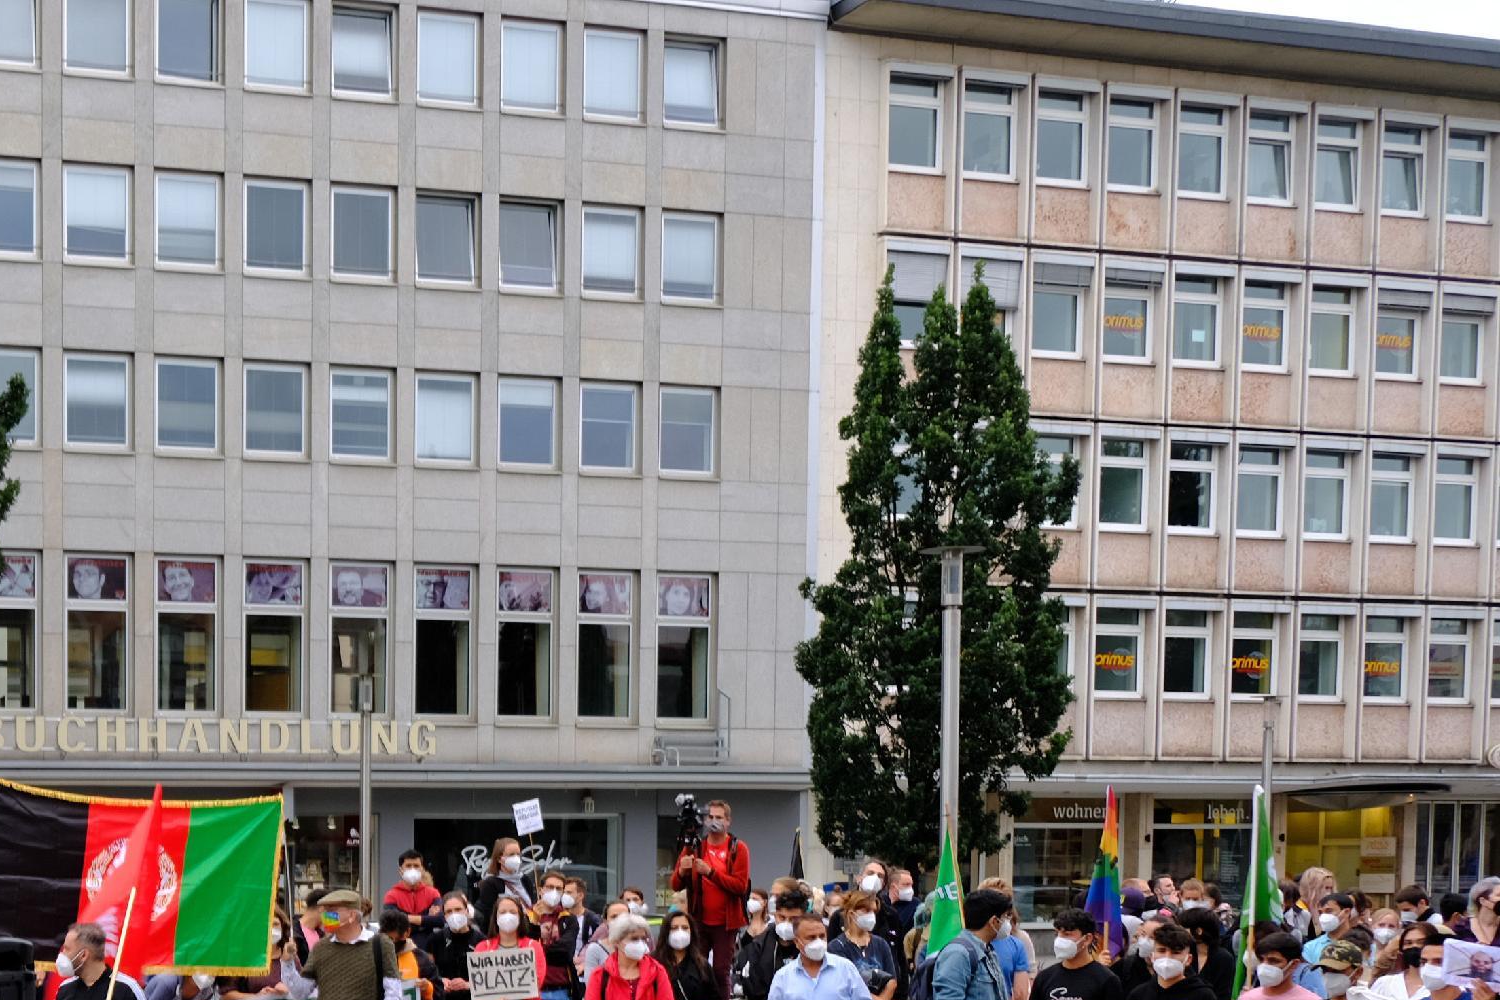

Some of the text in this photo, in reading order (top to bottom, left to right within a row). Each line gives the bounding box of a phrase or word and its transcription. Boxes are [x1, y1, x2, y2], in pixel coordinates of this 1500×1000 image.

[470, 950, 534, 970] WIR HABEN
[471, 966, 536, 991] PLATZ!
